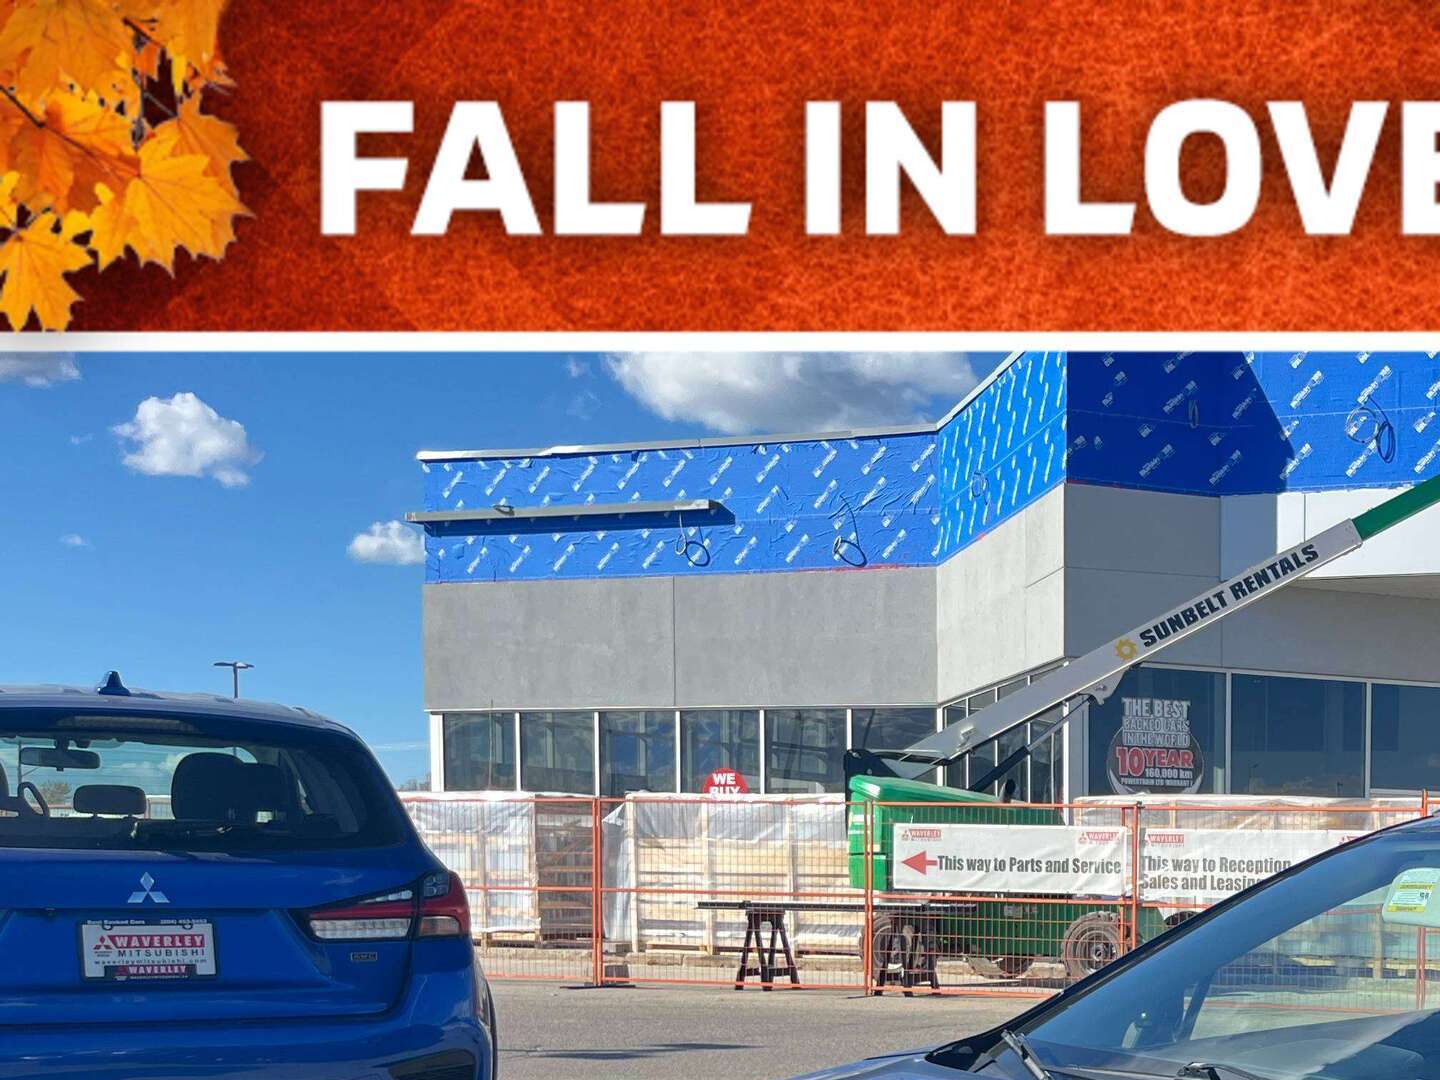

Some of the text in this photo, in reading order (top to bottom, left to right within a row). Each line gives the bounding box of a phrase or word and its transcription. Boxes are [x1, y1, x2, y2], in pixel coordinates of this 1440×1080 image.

[1139, 544, 1319, 647] SUNBELT RENTALS
[1121, 697, 1191, 720] THE BEST
[1135, 732, 1152, 746] THE
[1116, 747, 1194, 776] 10 YEAR
[712, 773, 736, 785] WE
[1179, 769, 1193, 778] km
[938, 856, 1121, 874] This way to Parts and Service
[1140, 856, 1169, 872] This
[1172, 858, 1199, 873] way
[1203, 858, 1216, 872] to
[1139, 874, 1263, 890] Sales and Leasin
[116, 936, 203, 947] WAVERLEY
[118, 949, 205, 957] MITSUBISHI
[129, 966, 187, 974] WAVERLEY
